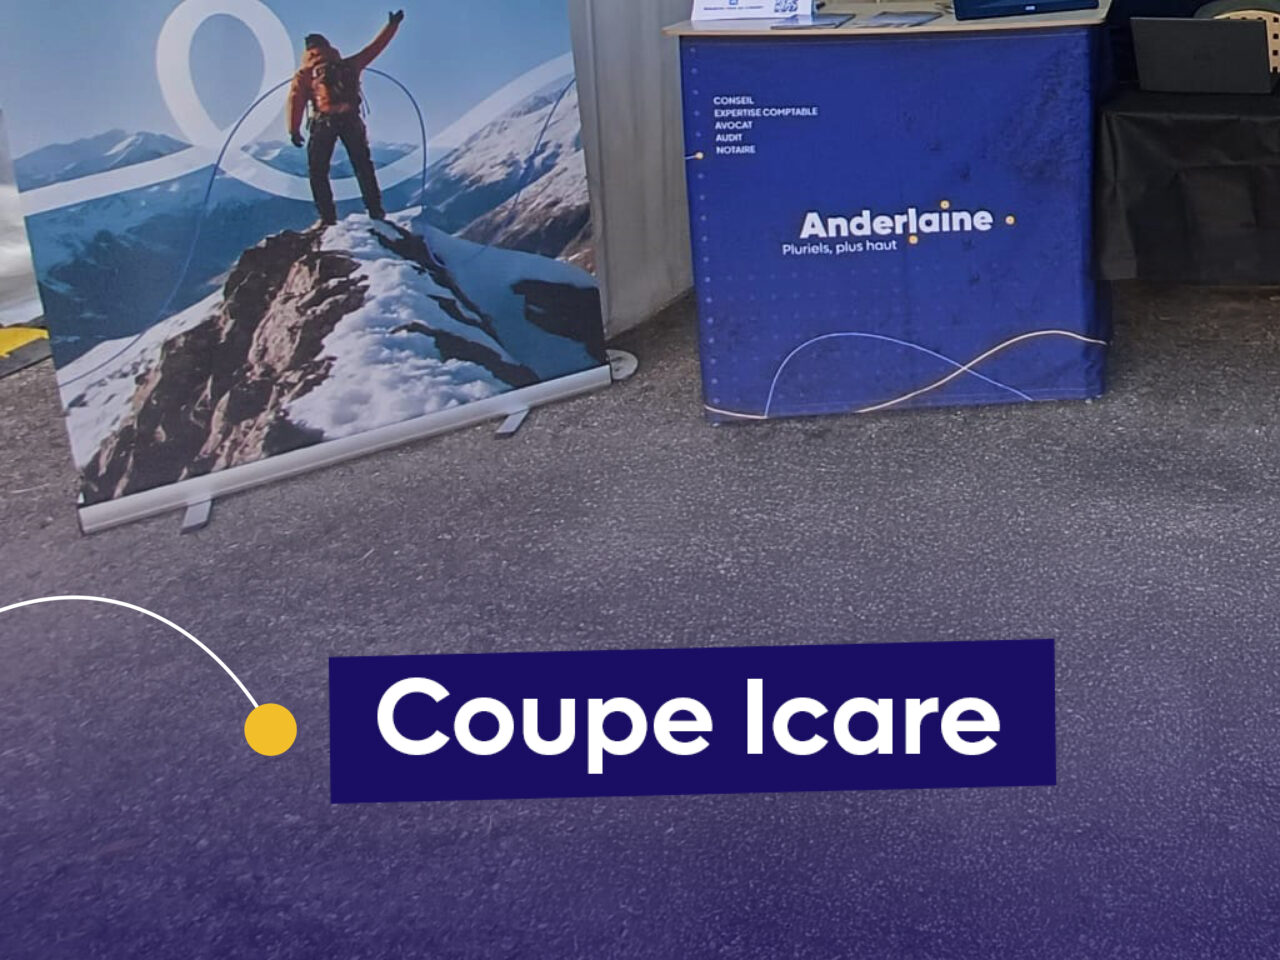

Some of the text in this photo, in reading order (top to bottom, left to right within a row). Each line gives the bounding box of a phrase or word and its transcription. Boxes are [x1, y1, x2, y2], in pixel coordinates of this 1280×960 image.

[713, 96, 755, 105] CONSEIL
[714, 106, 819, 118] EXPERTISE COMPTABLE
[715, 121, 753, 130] AVOCAT
[716, 133, 743, 142] AUDIT
[716, 145, 756, 154] NOTAIRE
[800, 201, 994, 241] Anderlaine
[782, 240, 898, 256] Pluriels, plus haut
